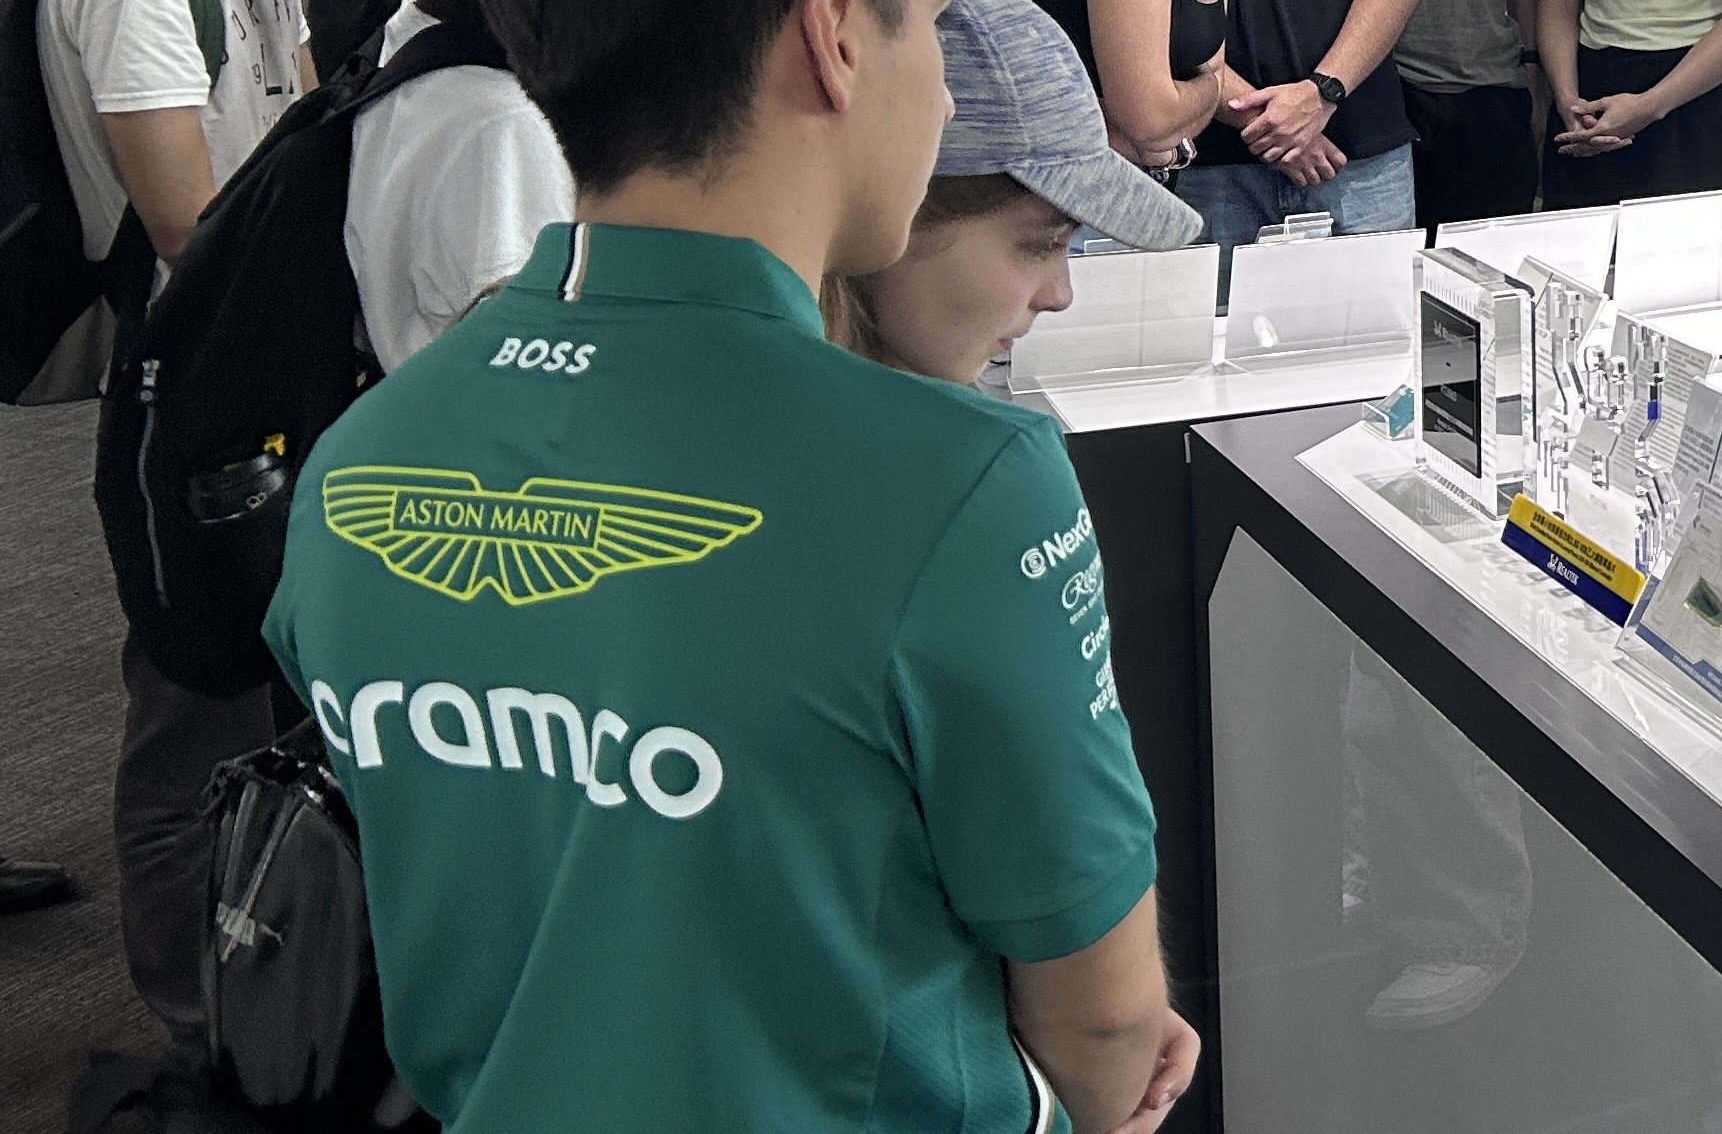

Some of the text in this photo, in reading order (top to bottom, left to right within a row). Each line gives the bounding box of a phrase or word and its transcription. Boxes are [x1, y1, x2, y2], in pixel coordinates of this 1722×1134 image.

[489, 337, 597, 374] BOSS
[400, 498, 593, 540] ASTON MARTIN
[311, 678, 724, 820] aramco
